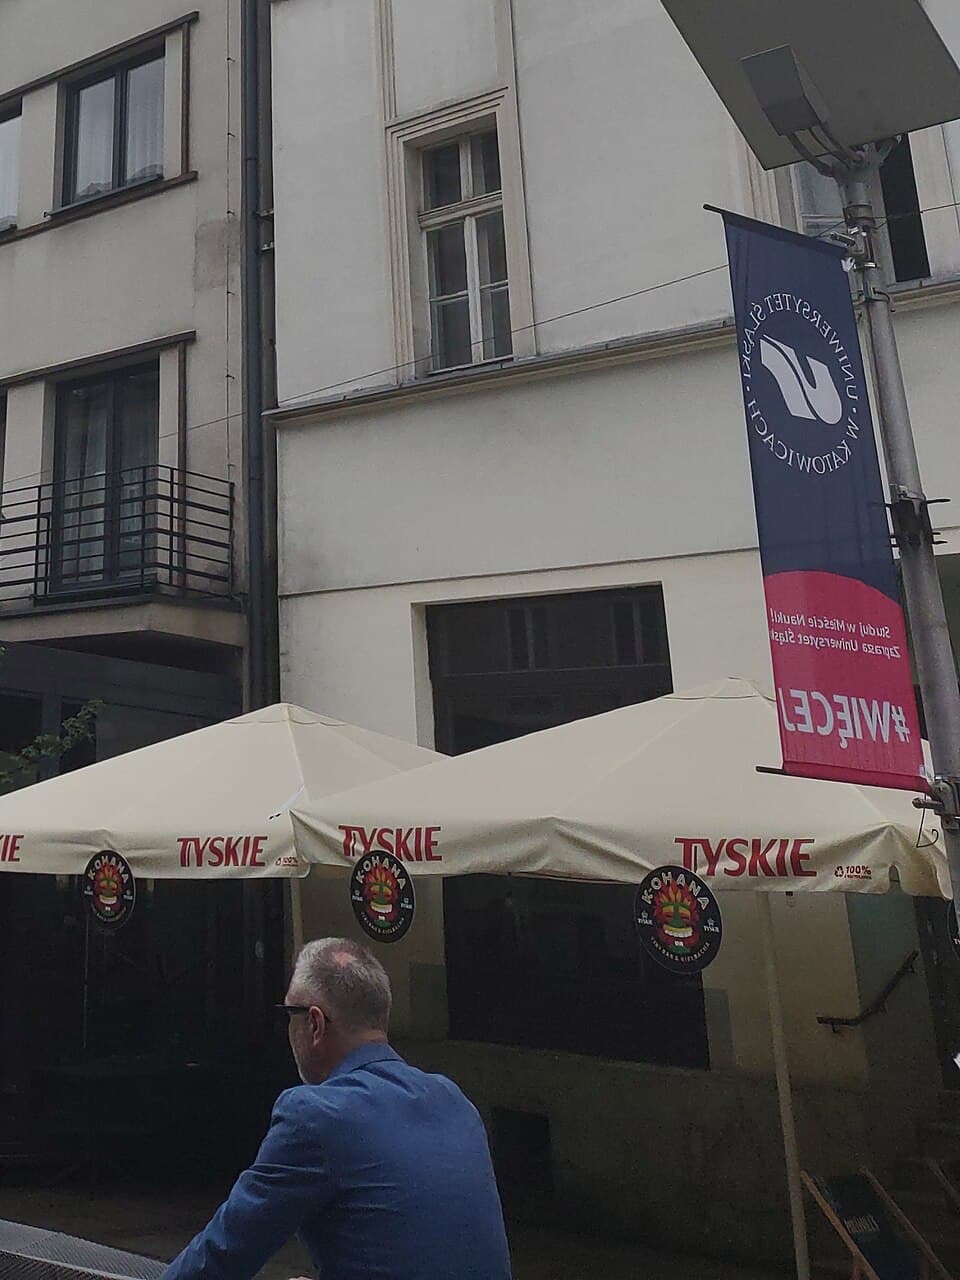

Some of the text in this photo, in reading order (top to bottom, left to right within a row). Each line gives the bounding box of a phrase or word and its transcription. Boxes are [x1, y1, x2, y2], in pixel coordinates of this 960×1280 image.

[176, 835, 269, 868] TYSKIE
[338, 824, 443, 863] TYSKIE
[674, 837, 817, 878] TYSKIE
[845, 865, 872, 875] 100%
[641, 871, 711, 911] K-OHANA
